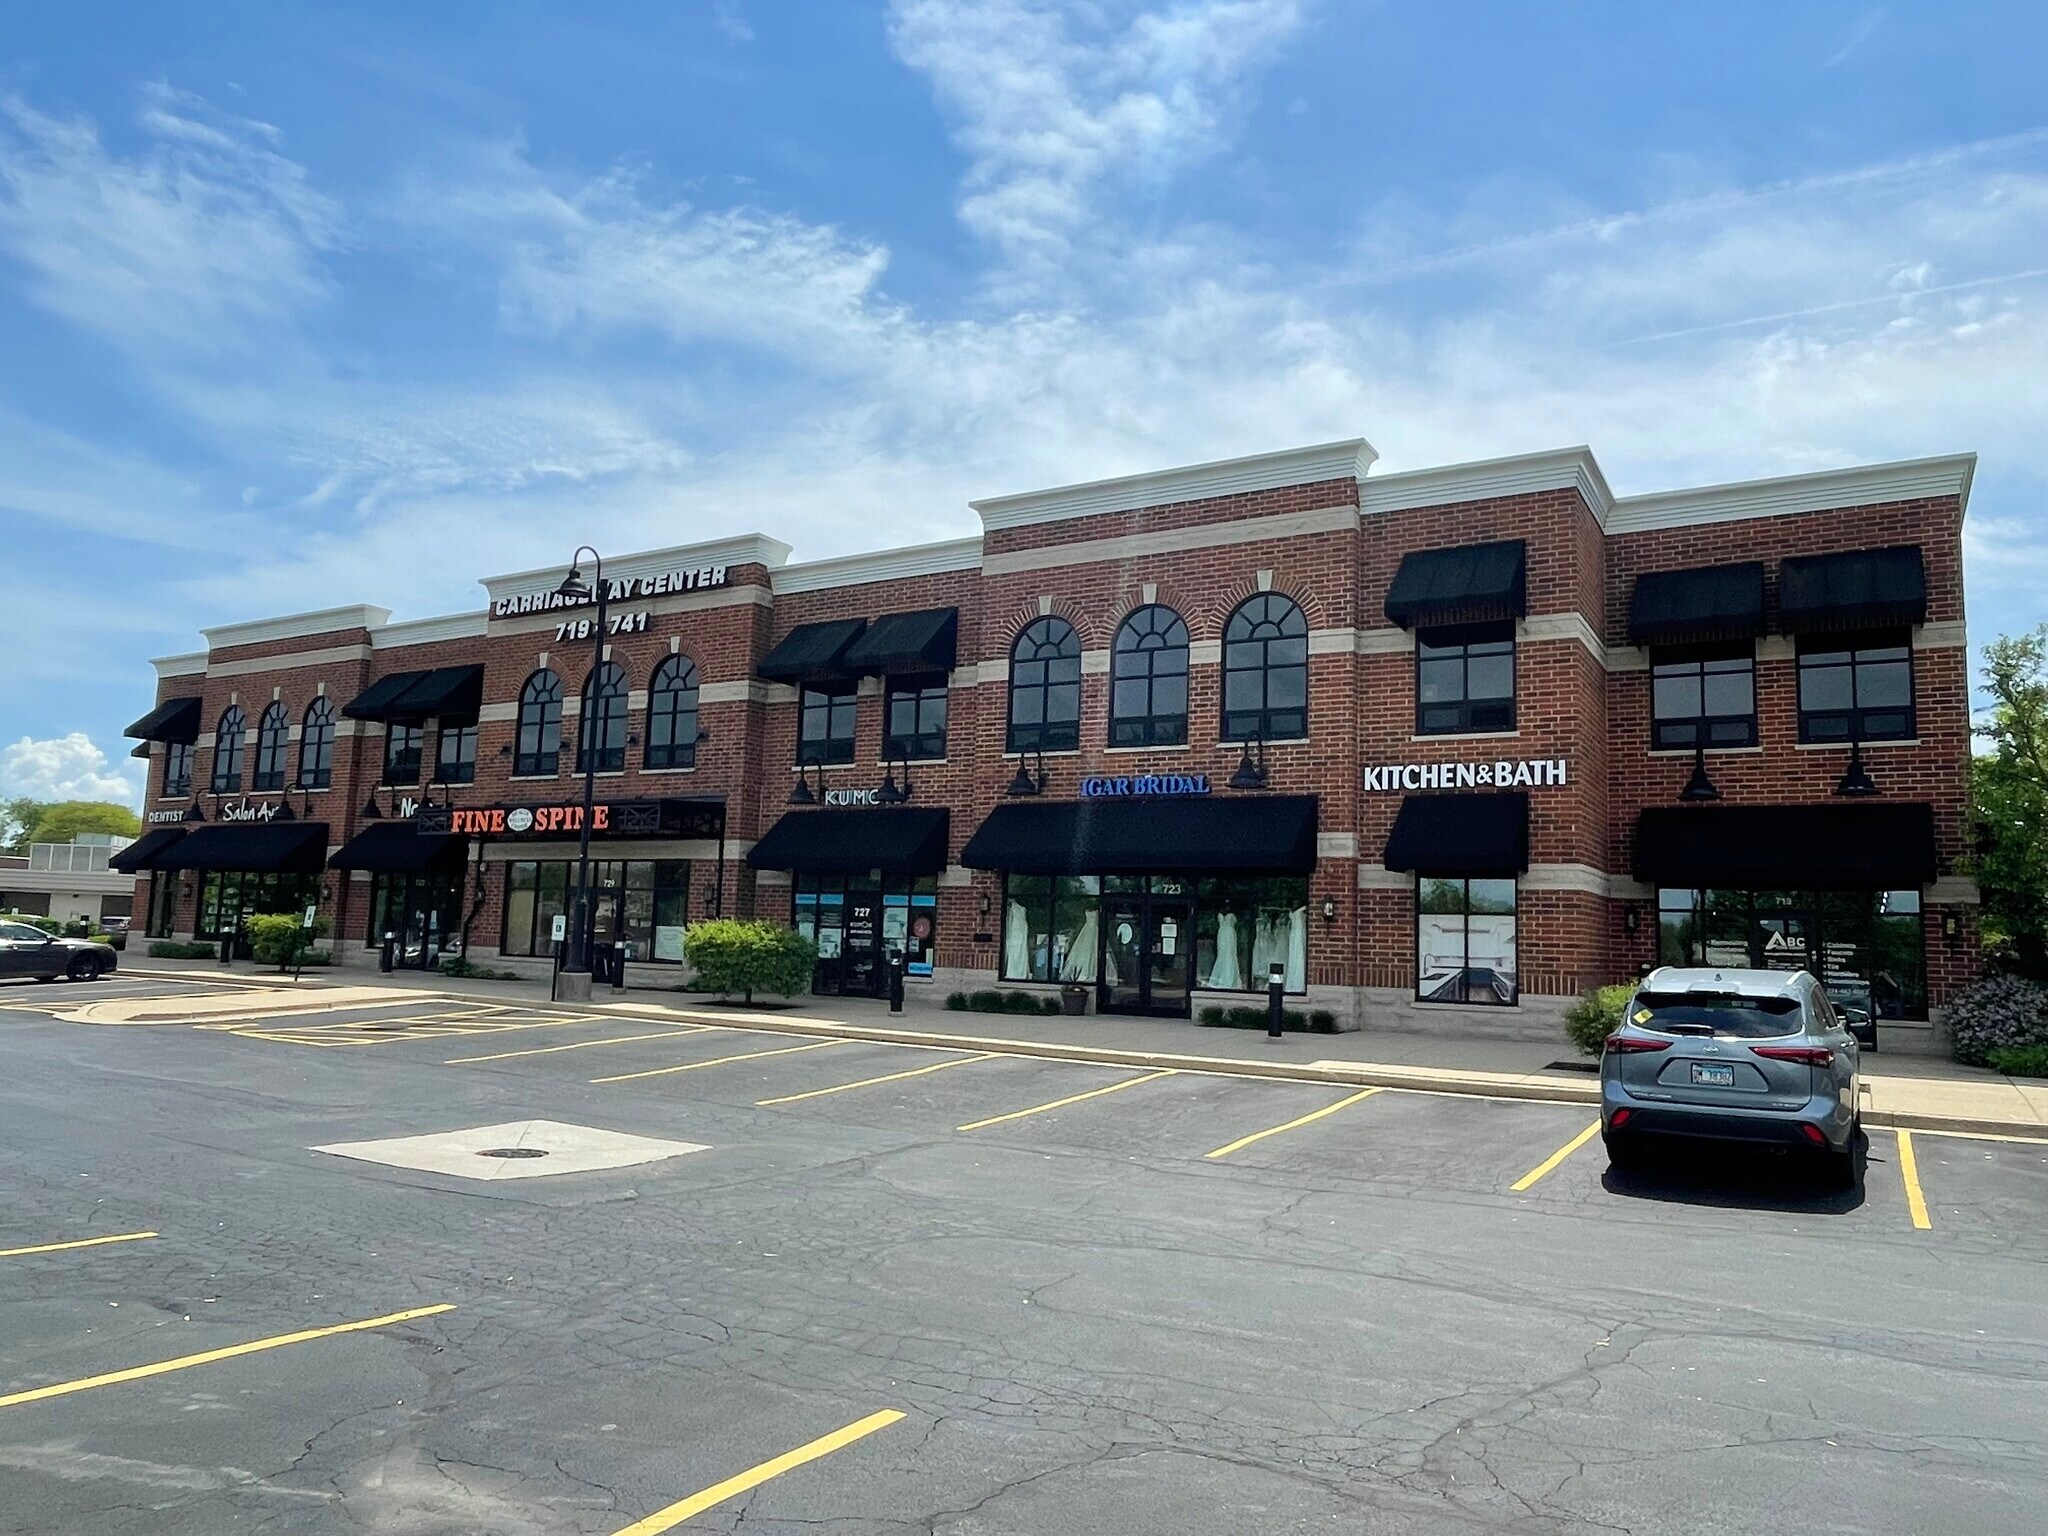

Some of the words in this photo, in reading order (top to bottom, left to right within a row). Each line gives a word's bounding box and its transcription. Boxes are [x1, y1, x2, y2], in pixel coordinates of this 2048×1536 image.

[640, 565, 726, 596] CENTER
[555, 619, 590, 643] 719
[610, 611, 647, 635] 741
[1080, 777, 1129, 796] IGAR
[1133, 774, 1210, 795] BRIDAL
[1364, 759, 1567, 791] KITCHEN&BATH
[148, 810, 184, 822] DENTIST
[222, 796, 255, 821] Salon
[451, 809, 505, 833] FINE
[534, 805, 609, 831] SPINE
[1163, 884, 1181, 895] 723
[854, 907, 871, 918] 727
